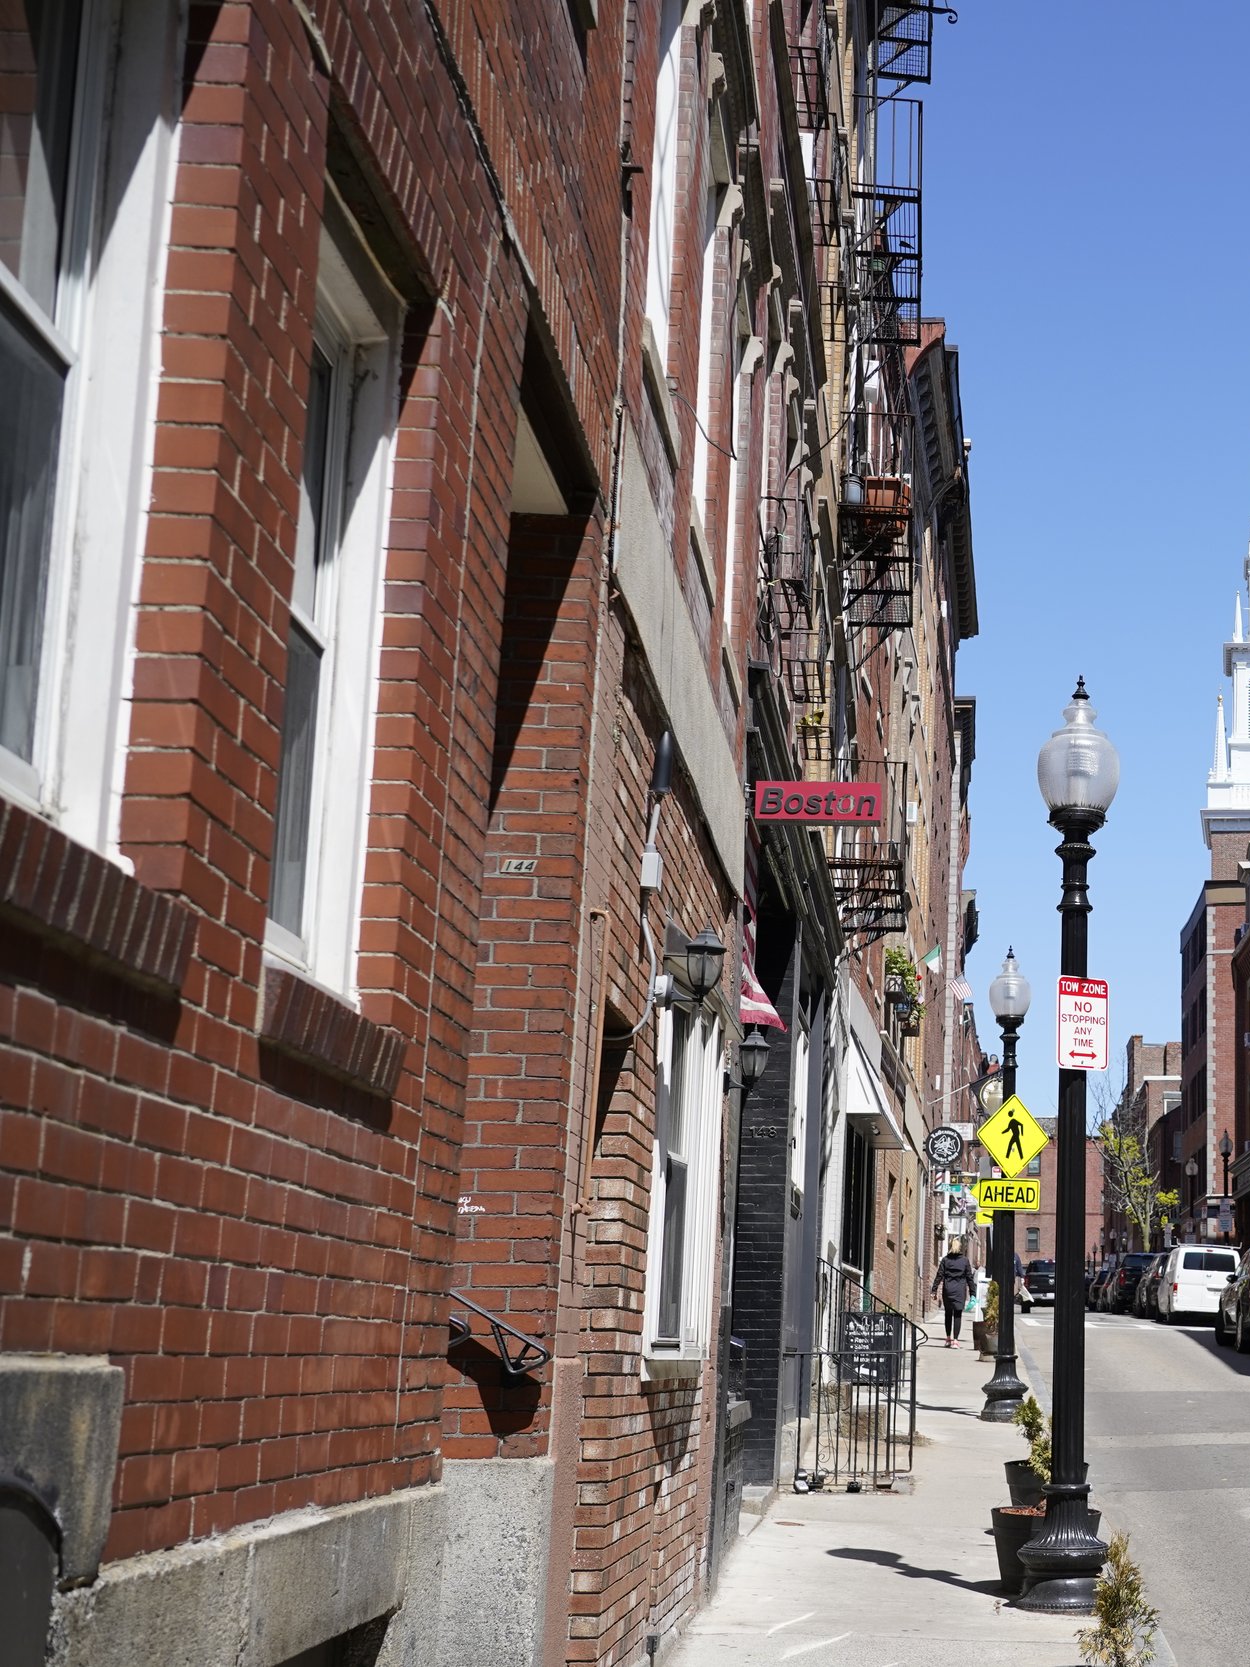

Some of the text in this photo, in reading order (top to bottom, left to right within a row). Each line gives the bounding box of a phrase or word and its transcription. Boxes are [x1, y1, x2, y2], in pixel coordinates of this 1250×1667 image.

[760, 787, 876, 816] Boston
[505, 861, 535, 871] 144
[1061, 981, 1107, 995] TOW ZONE
[1074, 1001, 1092, 1013] NO
[1061, 1013, 1106, 1026] STOPPING
[1074, 1026, 1093, 1035] ANY
[1073, 1037, 1094, 1048] TIME
[749, 1125, 777, 1139] 148
[983, 1185, 1036, 1203] AHEAD
